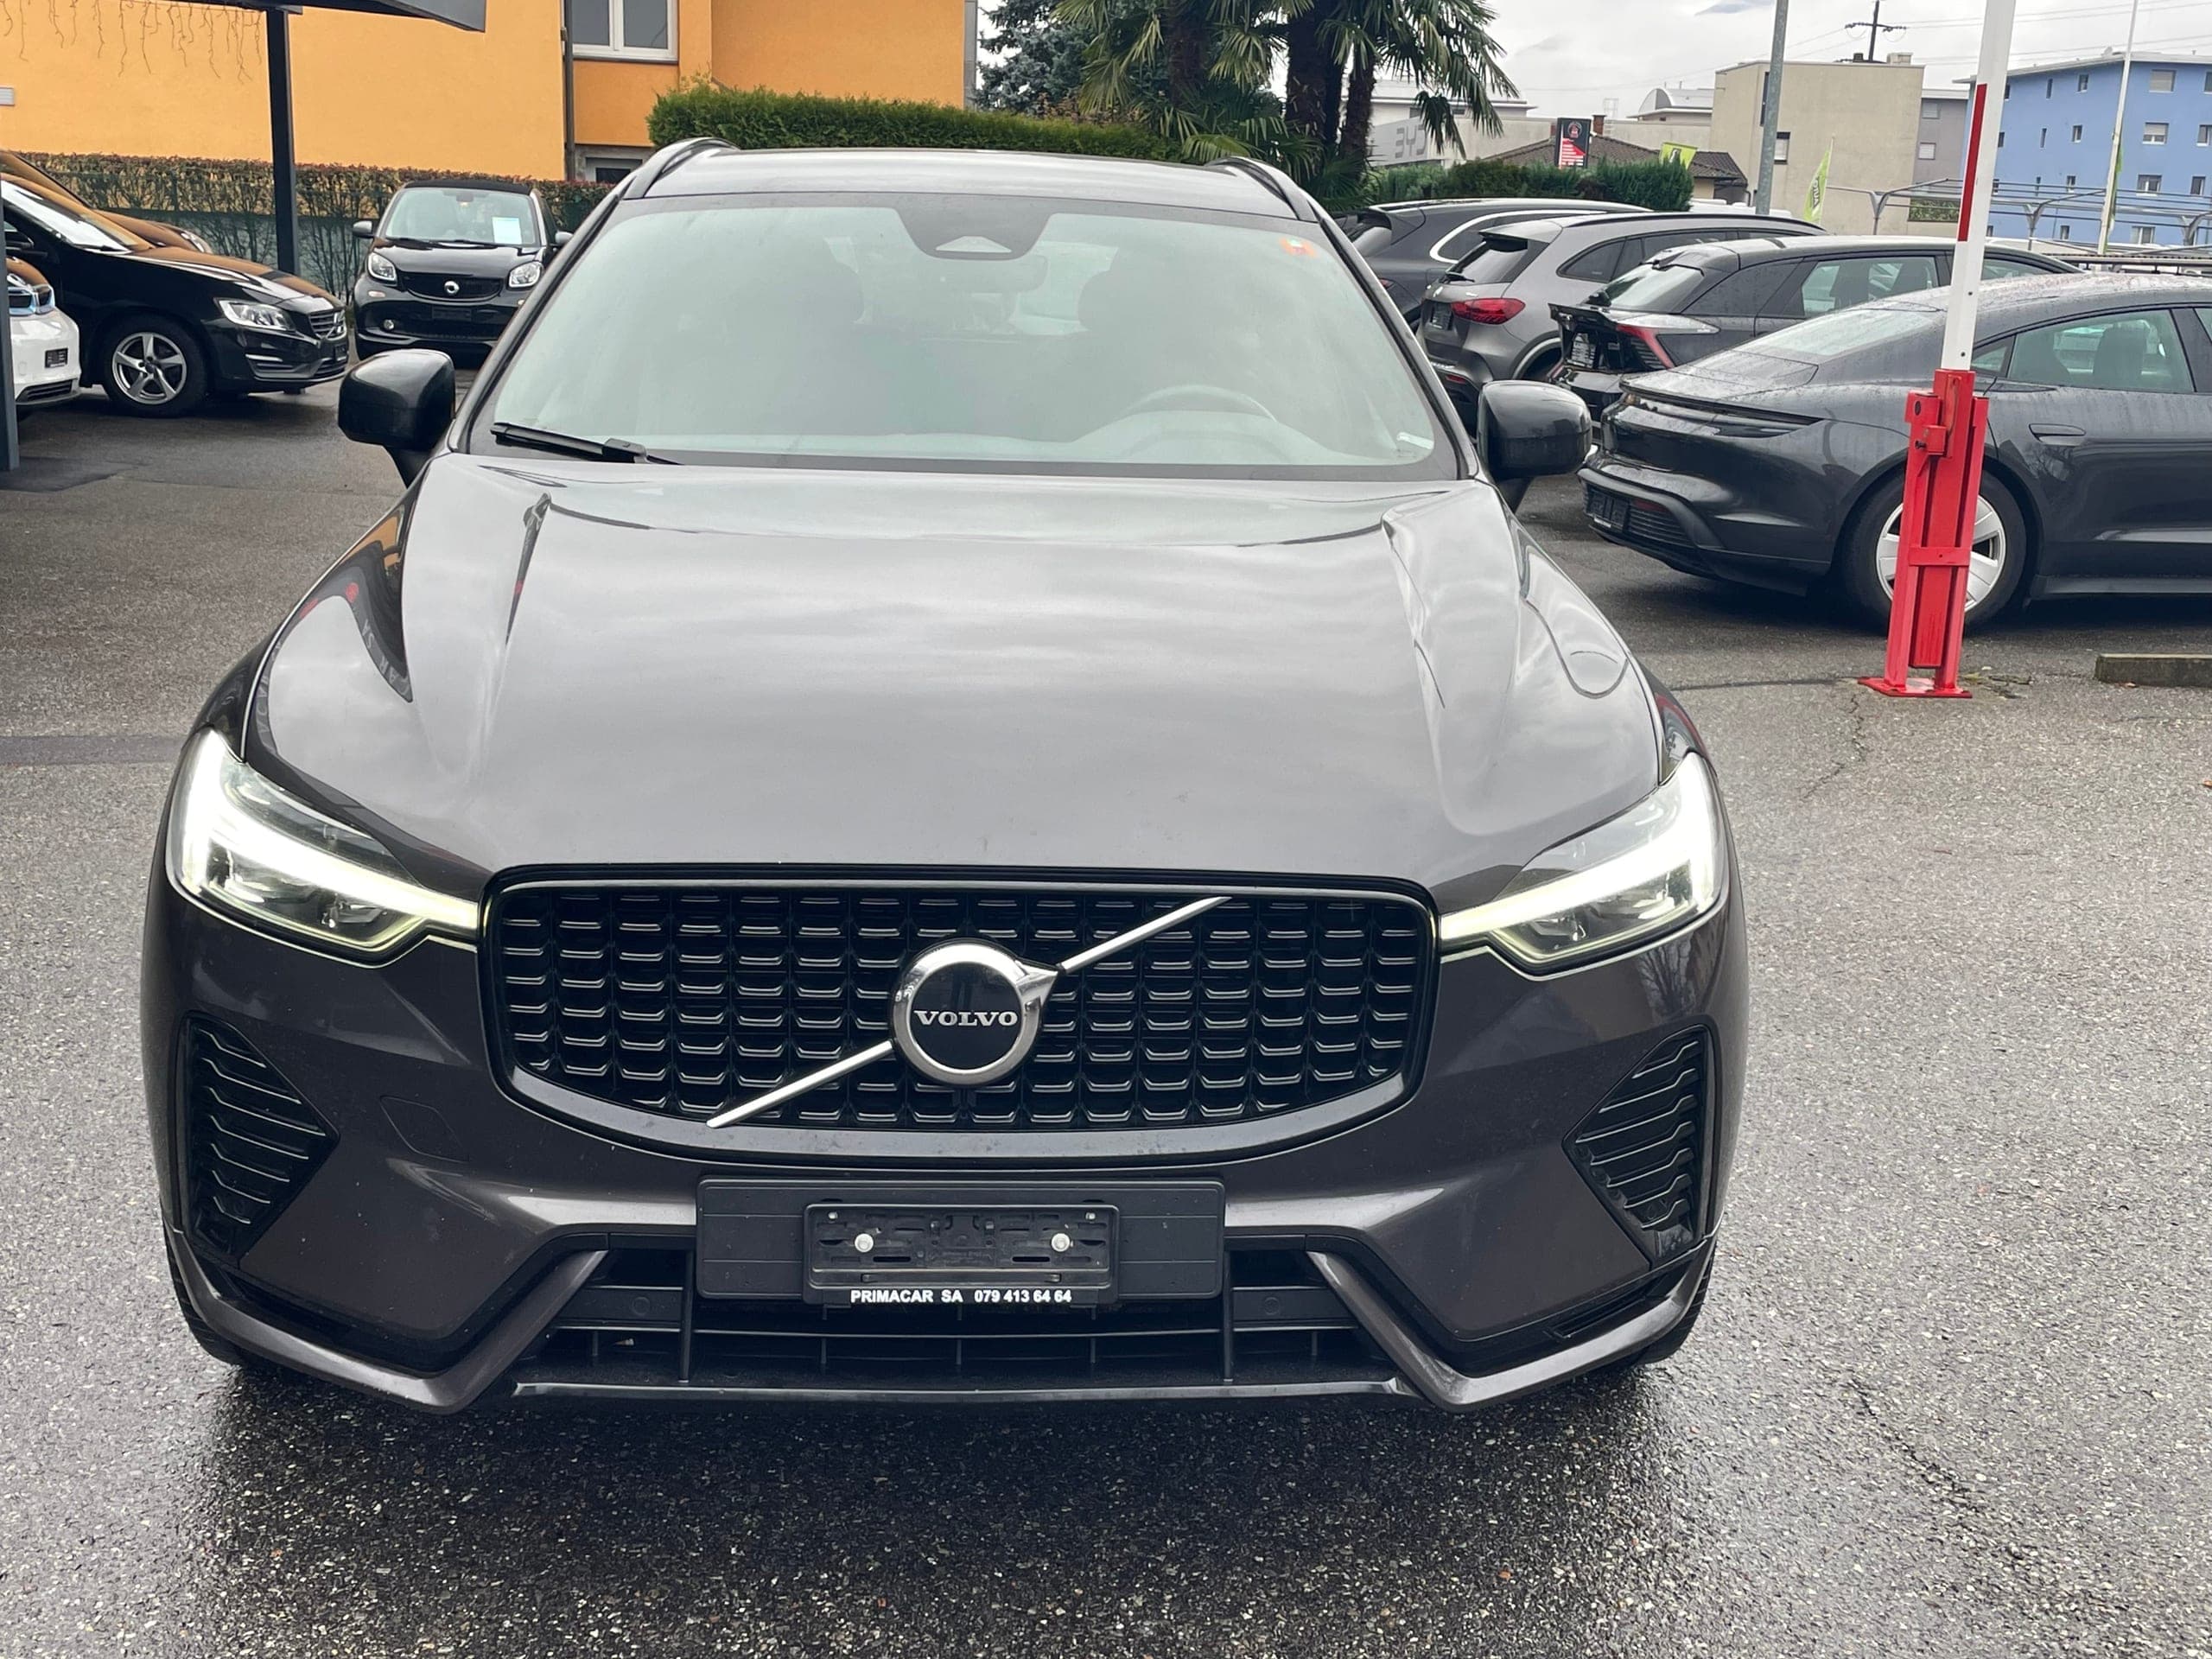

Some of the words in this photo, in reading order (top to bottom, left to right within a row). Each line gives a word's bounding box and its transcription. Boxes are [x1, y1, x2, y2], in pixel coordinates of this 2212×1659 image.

[913, 1010, 1018, 1027] VOLVO
[850, 1289, 934, 1303] PRIMACAR
[940, 1289, 963, 1303] SA
[974, 1289, 1001, 1303] 079
[1003, 1289, 1030, 1303] 413
[1033, 1289, 1052, 1303] 64
[1053, 1289, 1072, 1303] 64
